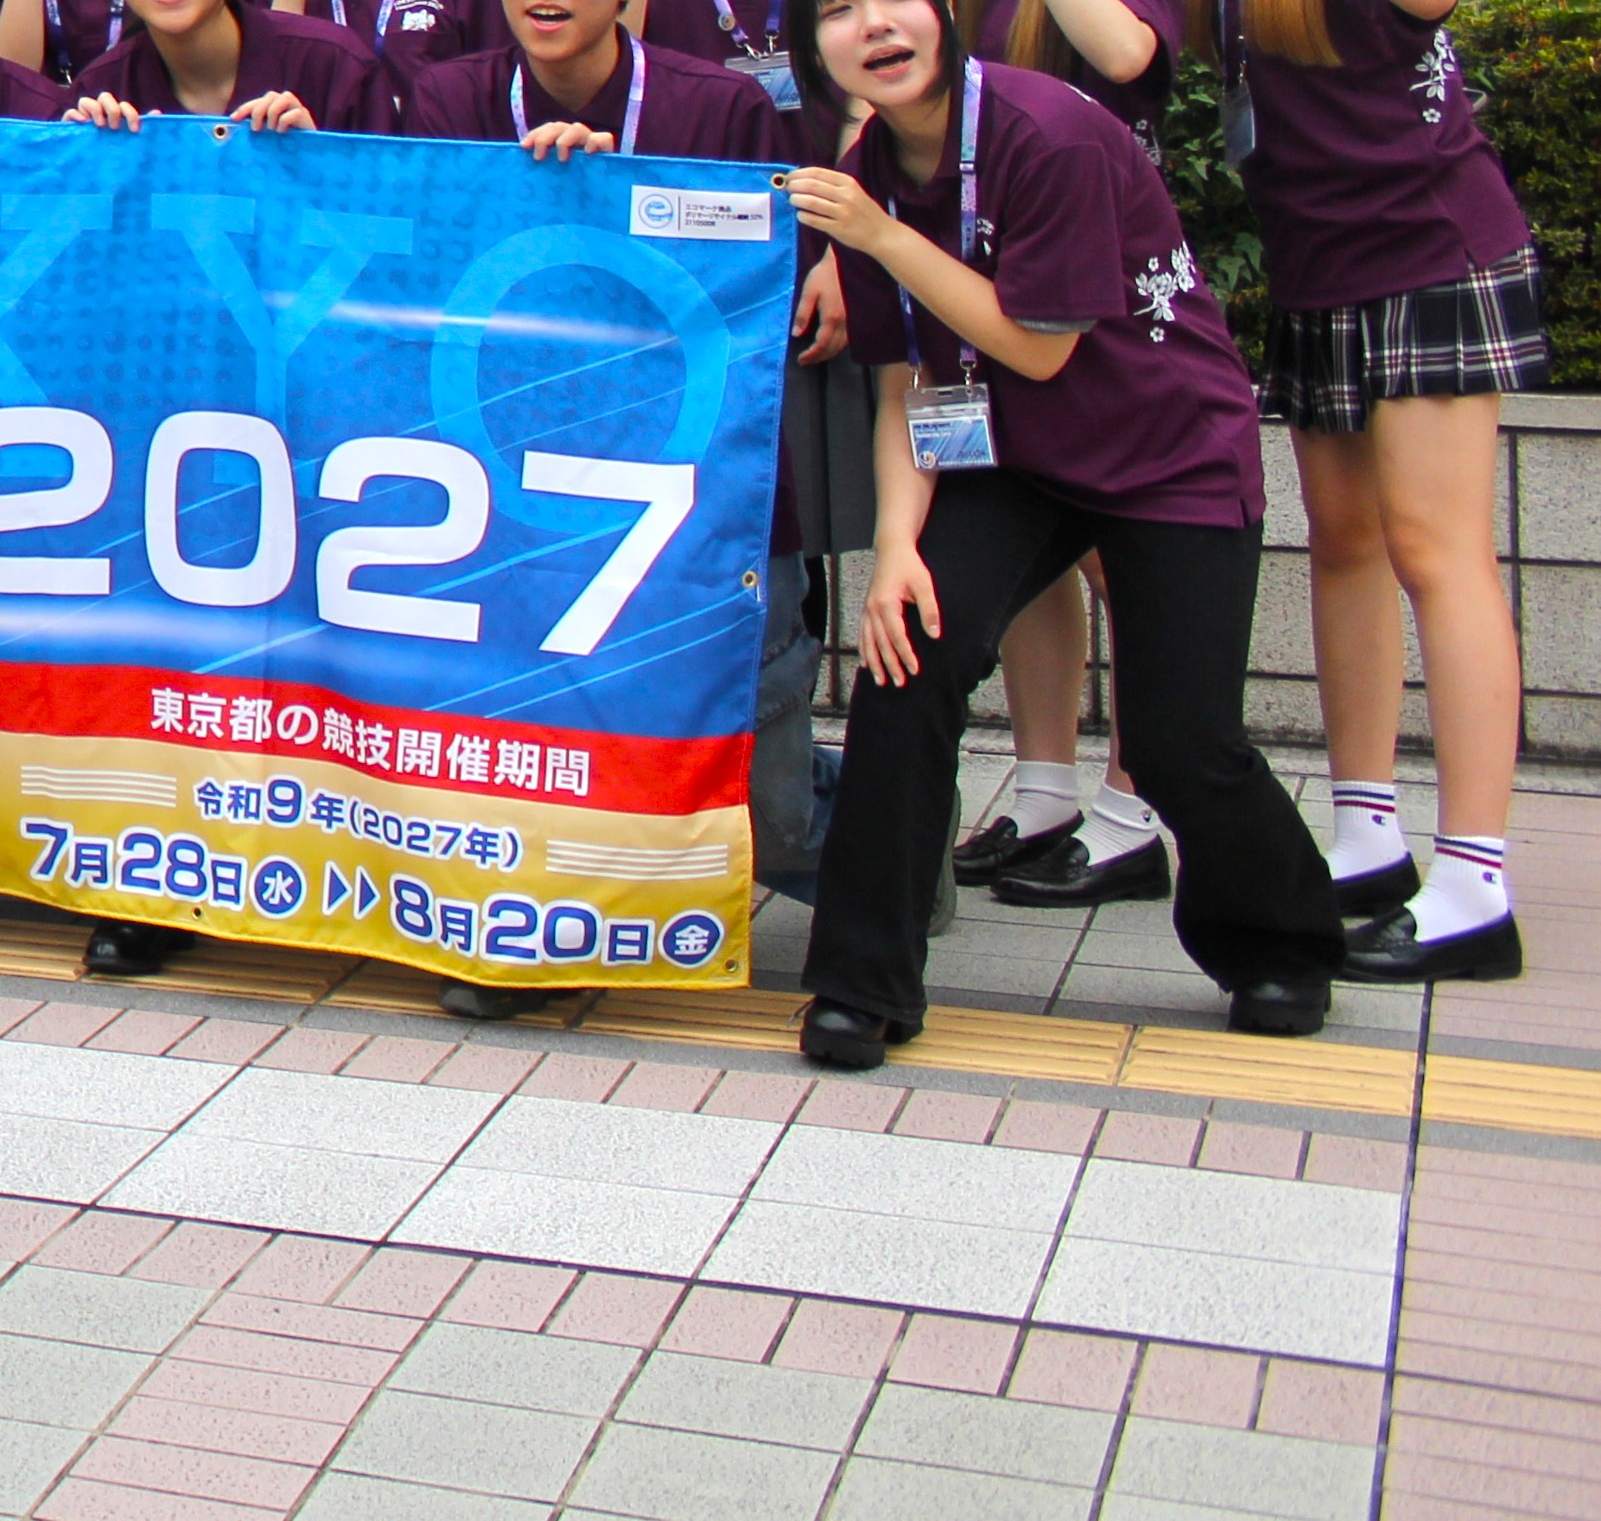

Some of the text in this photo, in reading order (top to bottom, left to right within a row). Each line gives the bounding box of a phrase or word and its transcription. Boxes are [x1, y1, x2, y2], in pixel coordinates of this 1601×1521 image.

[150, 688, 590, 796] 東京都の競技開催期間
